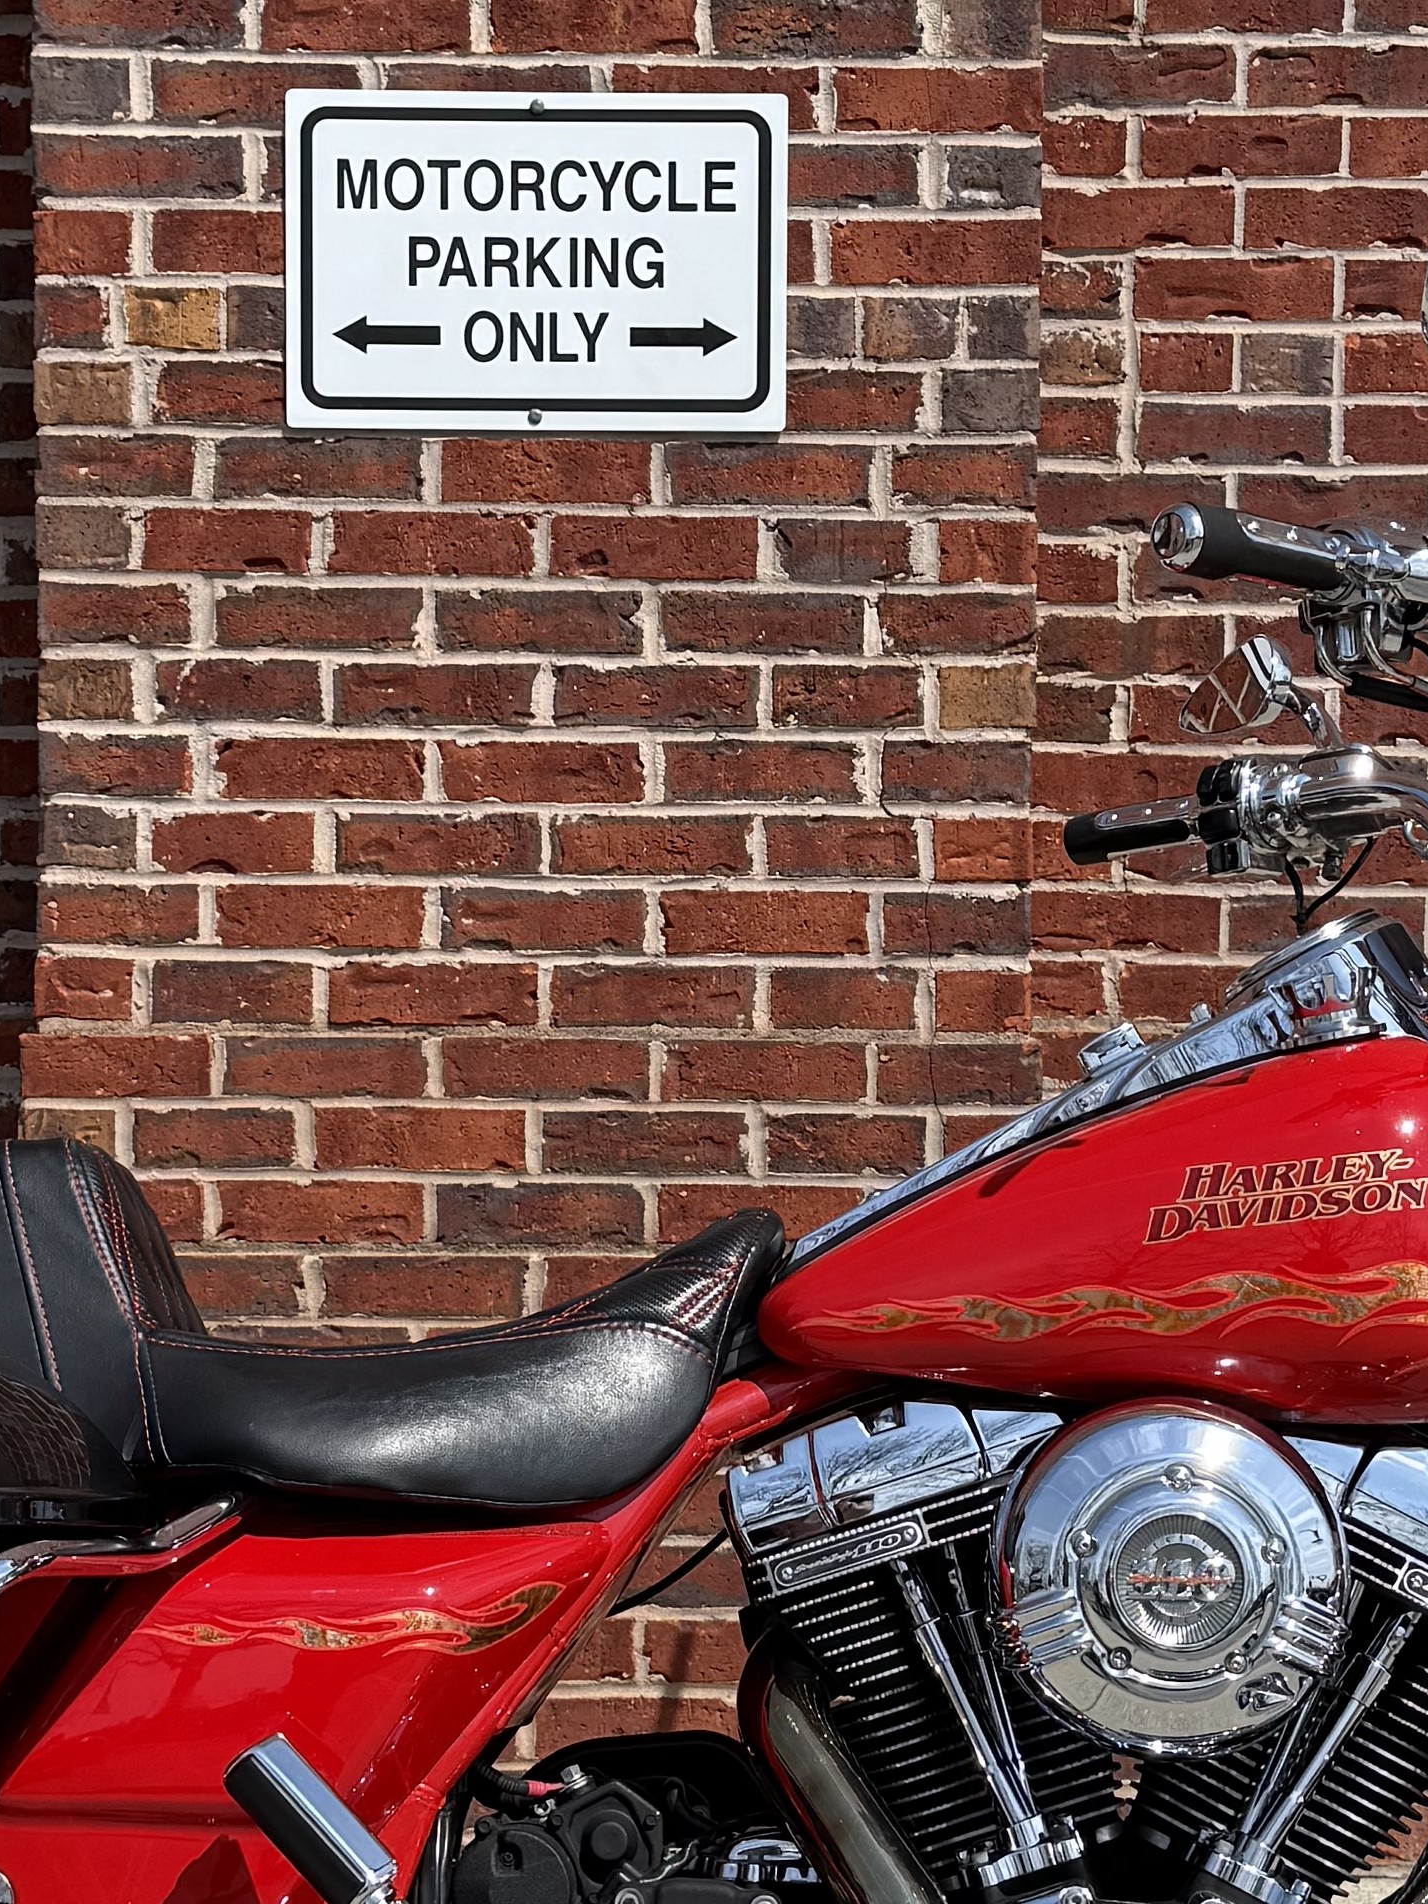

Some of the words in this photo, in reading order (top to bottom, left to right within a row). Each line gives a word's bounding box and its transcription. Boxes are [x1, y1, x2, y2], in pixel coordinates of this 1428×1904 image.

[336, 158, 737, 213] MOTORCYCLE
[408, 235, 665, 290] PARKING
[463, 310, 610, 364] ONLY
[1176, 1148, 1415, 1203] HARLEY-
